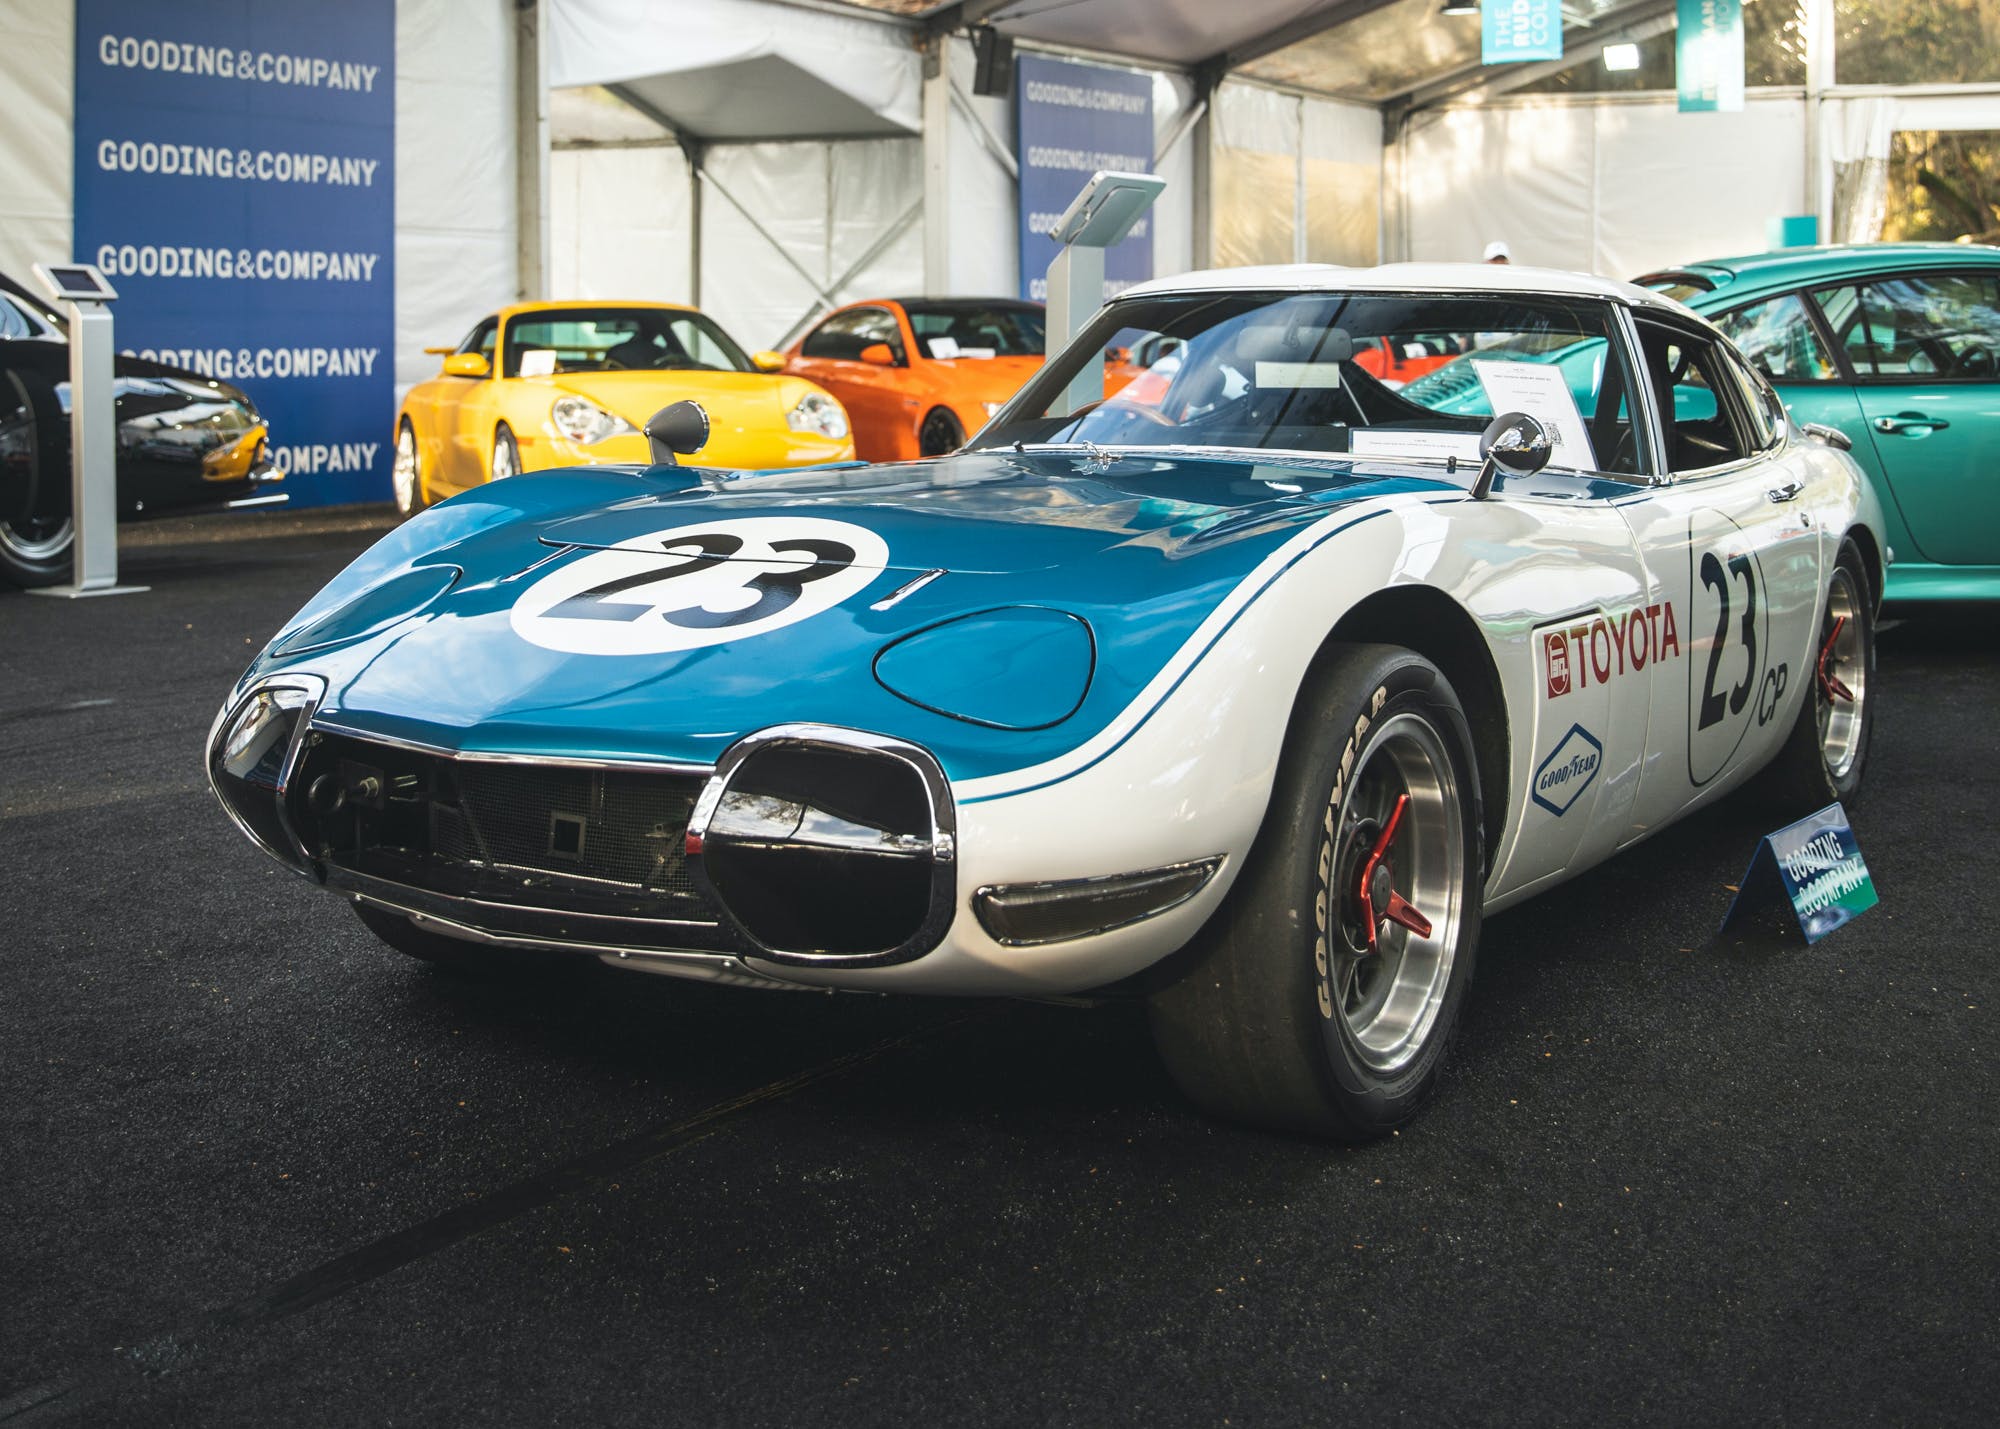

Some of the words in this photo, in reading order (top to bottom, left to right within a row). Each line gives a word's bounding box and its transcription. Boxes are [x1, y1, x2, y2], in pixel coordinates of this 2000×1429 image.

[99, 34, 377, 93] GOODING&COMPANY
[98, 139, 377, 188] GOODING&COMPANY
[97, 244, 377, 281] GOODING&COMPANY
[537, 533, 857, 630] 23
[1570, 601, 1680, 689] TOYOTA
[1698, 551, 1757, 732] 23
[1758, 662, 1788, 728] CP
[1785, 831, 1844, 882] GOODING
